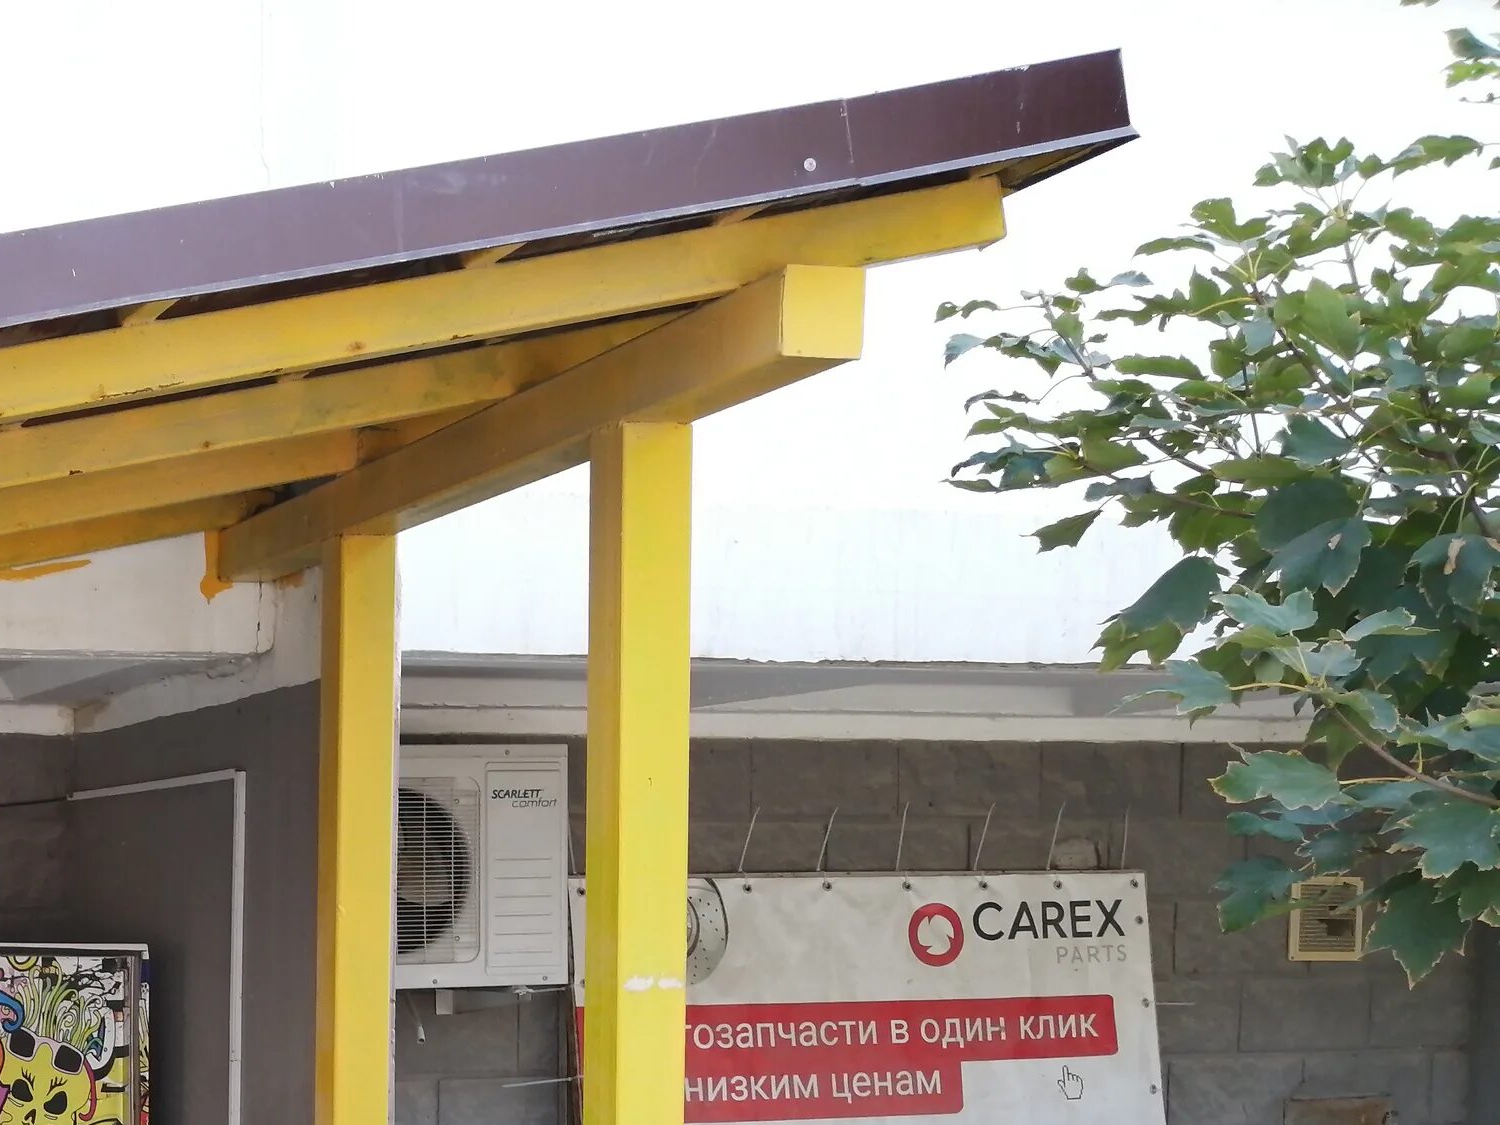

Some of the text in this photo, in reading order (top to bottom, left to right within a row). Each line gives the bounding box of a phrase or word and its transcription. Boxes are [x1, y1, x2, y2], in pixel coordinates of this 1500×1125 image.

[491, 788, 543, 800] SCARLETT
[511, 798, 558, 808] comfort
[973, 899, 1126, 941] CAREX
[1056, 944, 1127, 964] PARTS
[891, 1019, 910, 1044] в
[920, 1017, 1007, 1049] один
[1019, 1013, 1099, 1040] клик
[685, 1069, 942, 1105] низким ценам
